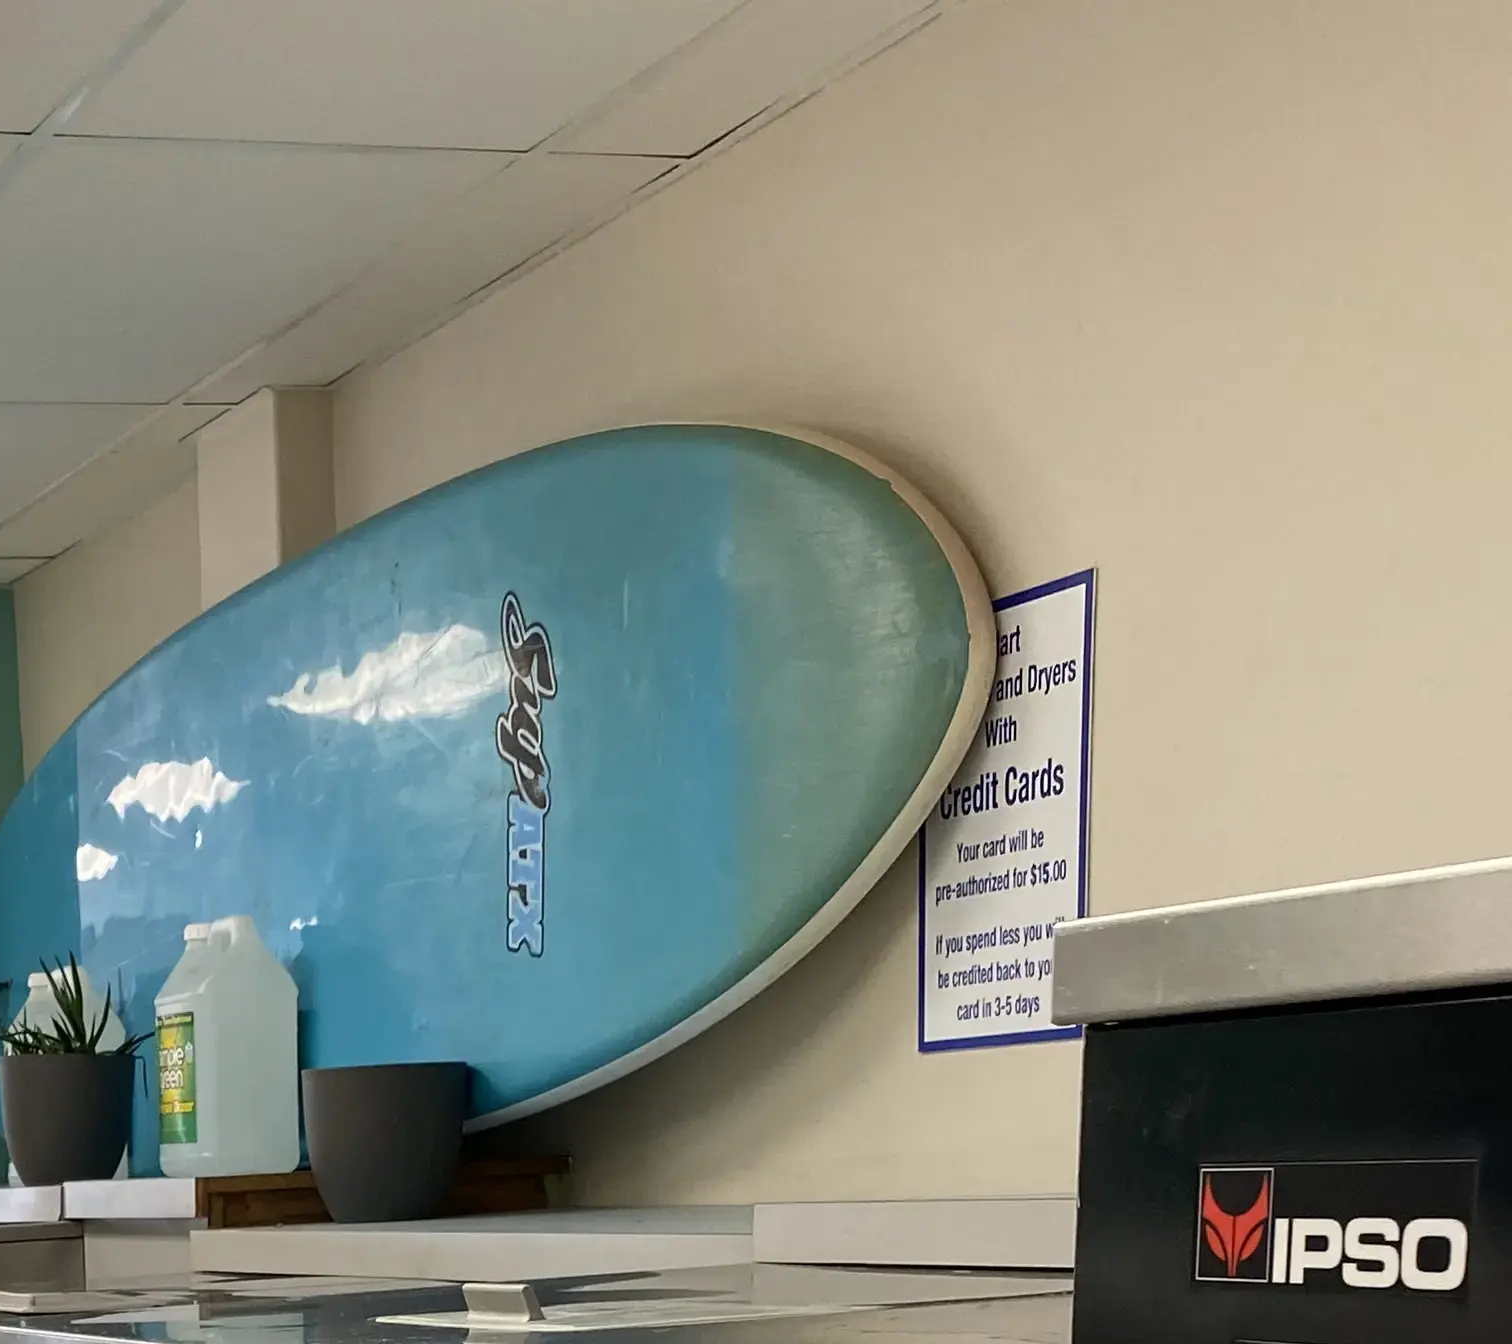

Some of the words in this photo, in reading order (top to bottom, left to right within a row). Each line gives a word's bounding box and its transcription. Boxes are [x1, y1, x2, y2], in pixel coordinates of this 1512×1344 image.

[996, 667, 1023, 701] and
[1027, 659, 1077, 695] Dryers
[985, 715, 1017, 748] With
[940, 772, 999, 820] Credit
[1004, 757, 1065, 806] Cards
[956, 842, 981, 864] Your
[982, 834, 1006, 858] card
[1009, 829, 1028, 852] will
[1031, 828, 1044, 849] be
[935, 868, 1010, 906] pre-authorized
[1013, 867, 1028, 888] for
[1030, 859, 1067, 888] $15.00
[936, 934, 943, 955] If
[945, 939, 963, 959] you
[965, 926, 997, 954] spend
[999, 925, 1020, 946] less
[1023, 923, 1043, 947] you
[937, 969, 950, 989] be
[952, 961, 993, 987] credited
[996, 958, 1022, 981] back
[1025, 957, 1035, 976] to
[1038, 958, 1053, 981] yo
[956, 999, 980, 1021] card
[982, 999, 992, 1018] in
[994, 995, 1012, 1016] 3-5
[1015, 994, 1040, 1018] days
[1272, 1216, 1469, 1291] IPSO
